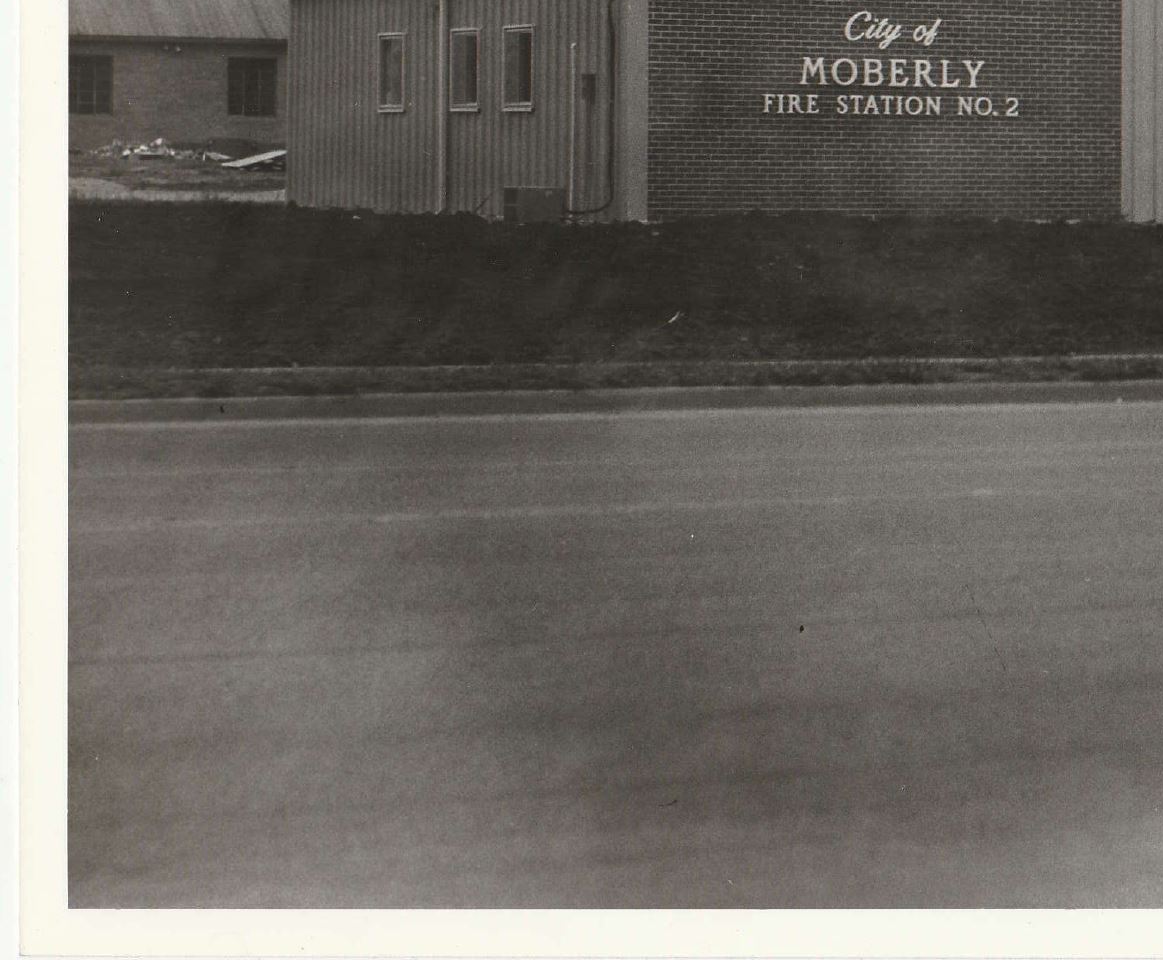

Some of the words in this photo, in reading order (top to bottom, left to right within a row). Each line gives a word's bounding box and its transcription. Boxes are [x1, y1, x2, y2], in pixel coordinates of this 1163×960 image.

[844, 11, 901, 49] City
[913, 19, 941, 46] of
[800, 57, 985, 89] MOBERLY
[762, 94, 819, 114] FIRE
[836, 95, 941, 117] STATION
[957, 96, 998, 116] NO.
[1005, 97, 1020, 117] 2
